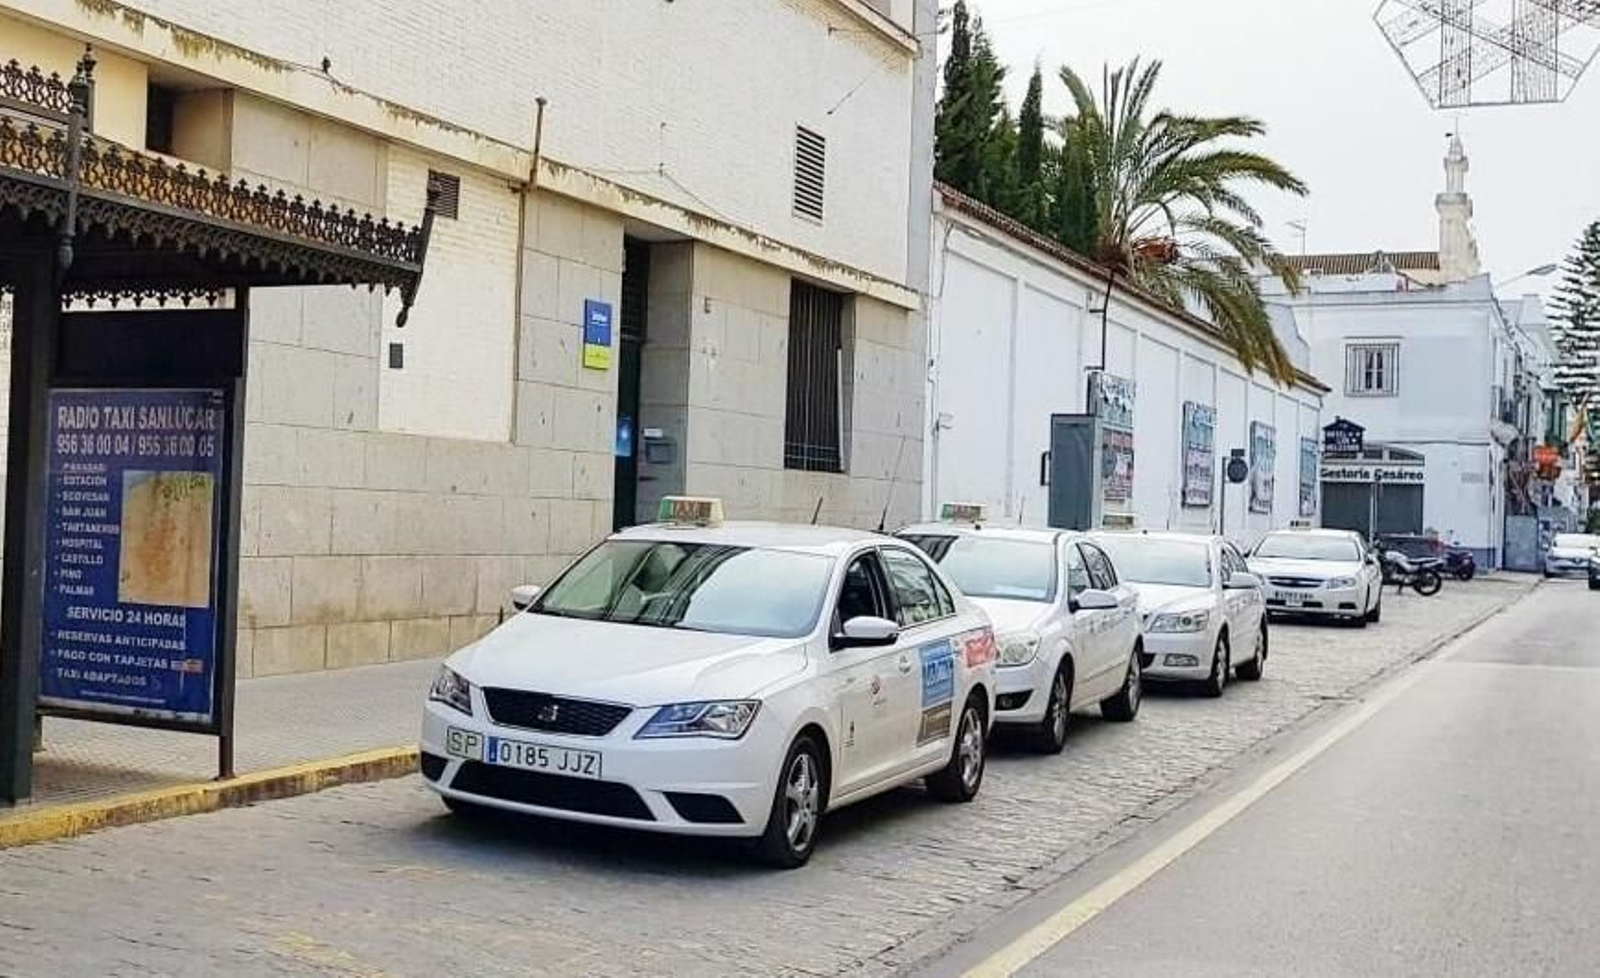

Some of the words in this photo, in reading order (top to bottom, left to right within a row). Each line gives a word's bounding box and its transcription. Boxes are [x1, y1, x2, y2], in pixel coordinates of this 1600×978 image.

[58, 405, 99, 429] RADIO
[104, 406, 135, 429] TAXI
[58, 433, 78, 455] 956
[81, 433, 94, 455] 36
[97, 434, 111, 456] 00
[115, 435, 129, 457] 04
[199, 436, 214, 457] 05
[62, 538, 103, 549] HOSPITAL
[59, 584, 95, 596] PALMAR
[67, 606, 123, 622] SERVICIO
[126, 610, 142, 624] 24
[144, 613, 186, 627] HORAS
[58, 631, 112, 644] RESERVAS
[115, 636, 186, 650] ANTICIPADAS
[58, 649, 86, 660] PAGO
[88, 652, 111, 663] CON
[114, 655, 168, 669] TARJETAS
[83, 672, 147, 686] ADAPTADOS
[451, 731, 478, 754] SP
[500, 742, 549, 768] 0185
[557, 752, 596, 775] JJZ
